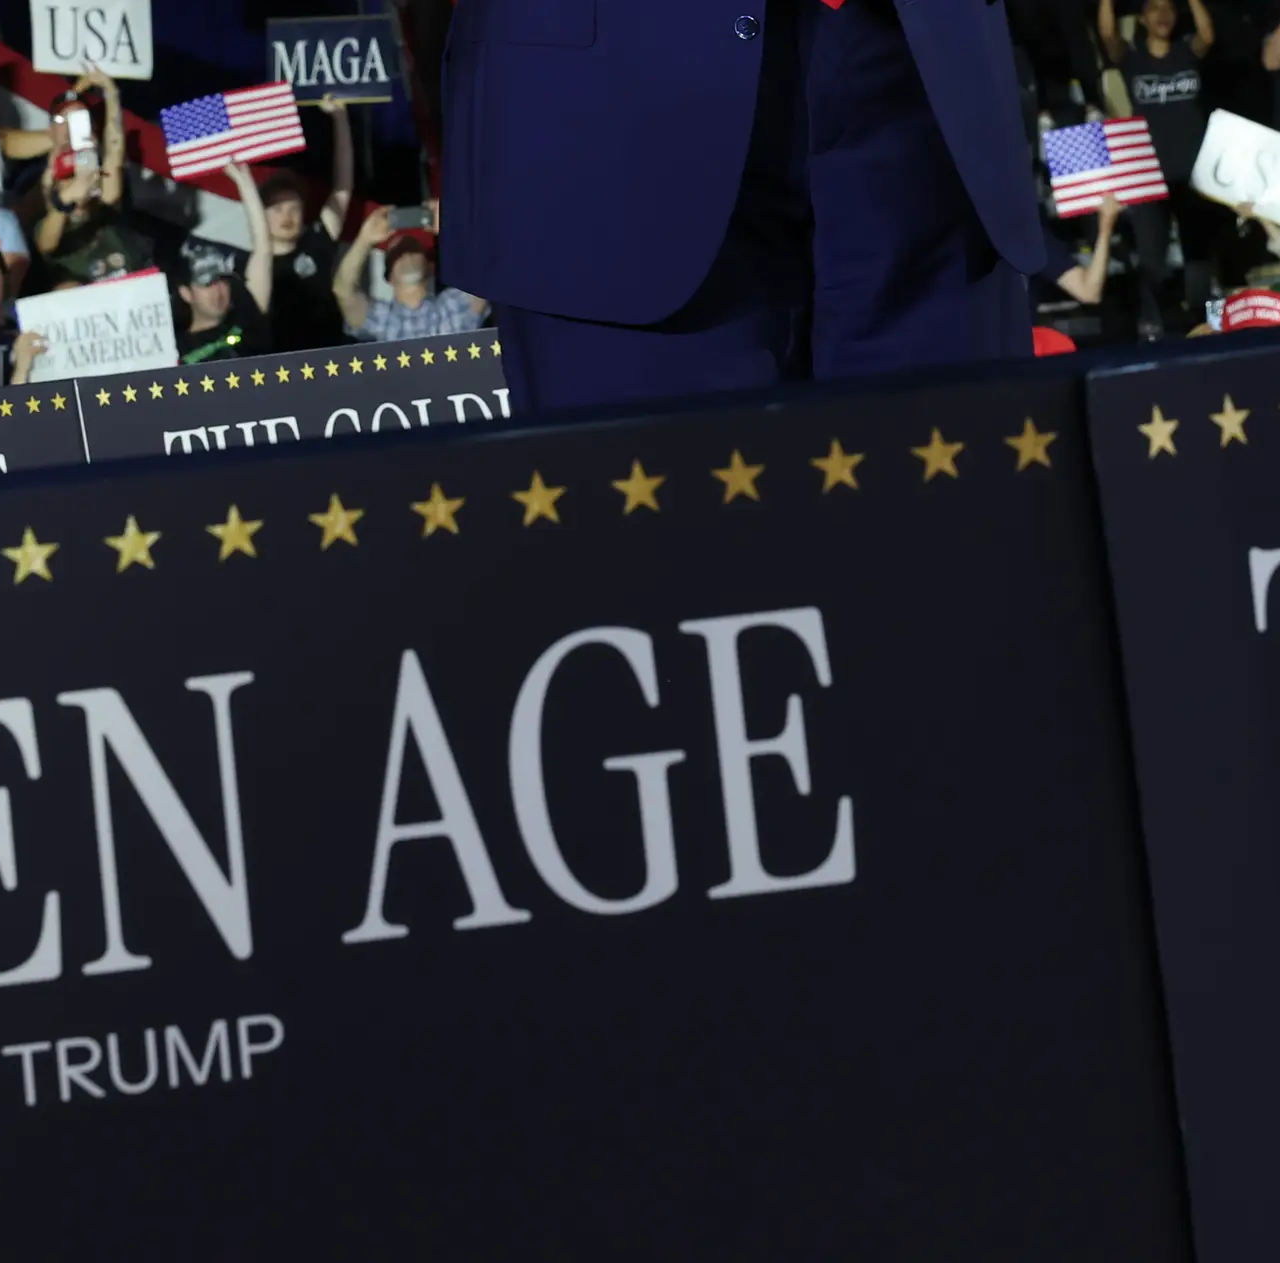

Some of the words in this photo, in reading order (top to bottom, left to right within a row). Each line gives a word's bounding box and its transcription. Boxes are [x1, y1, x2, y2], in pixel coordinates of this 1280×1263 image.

[47, 5, 143, 66] USA
[272, 36, 391, 85] MAGA
[128, 302, 169, 333] AGE
[64, 333, 164, 369] AMERICA
[341, 606, 857, 943] AGE
[2, 1013, 286, 1106] TRUMP
